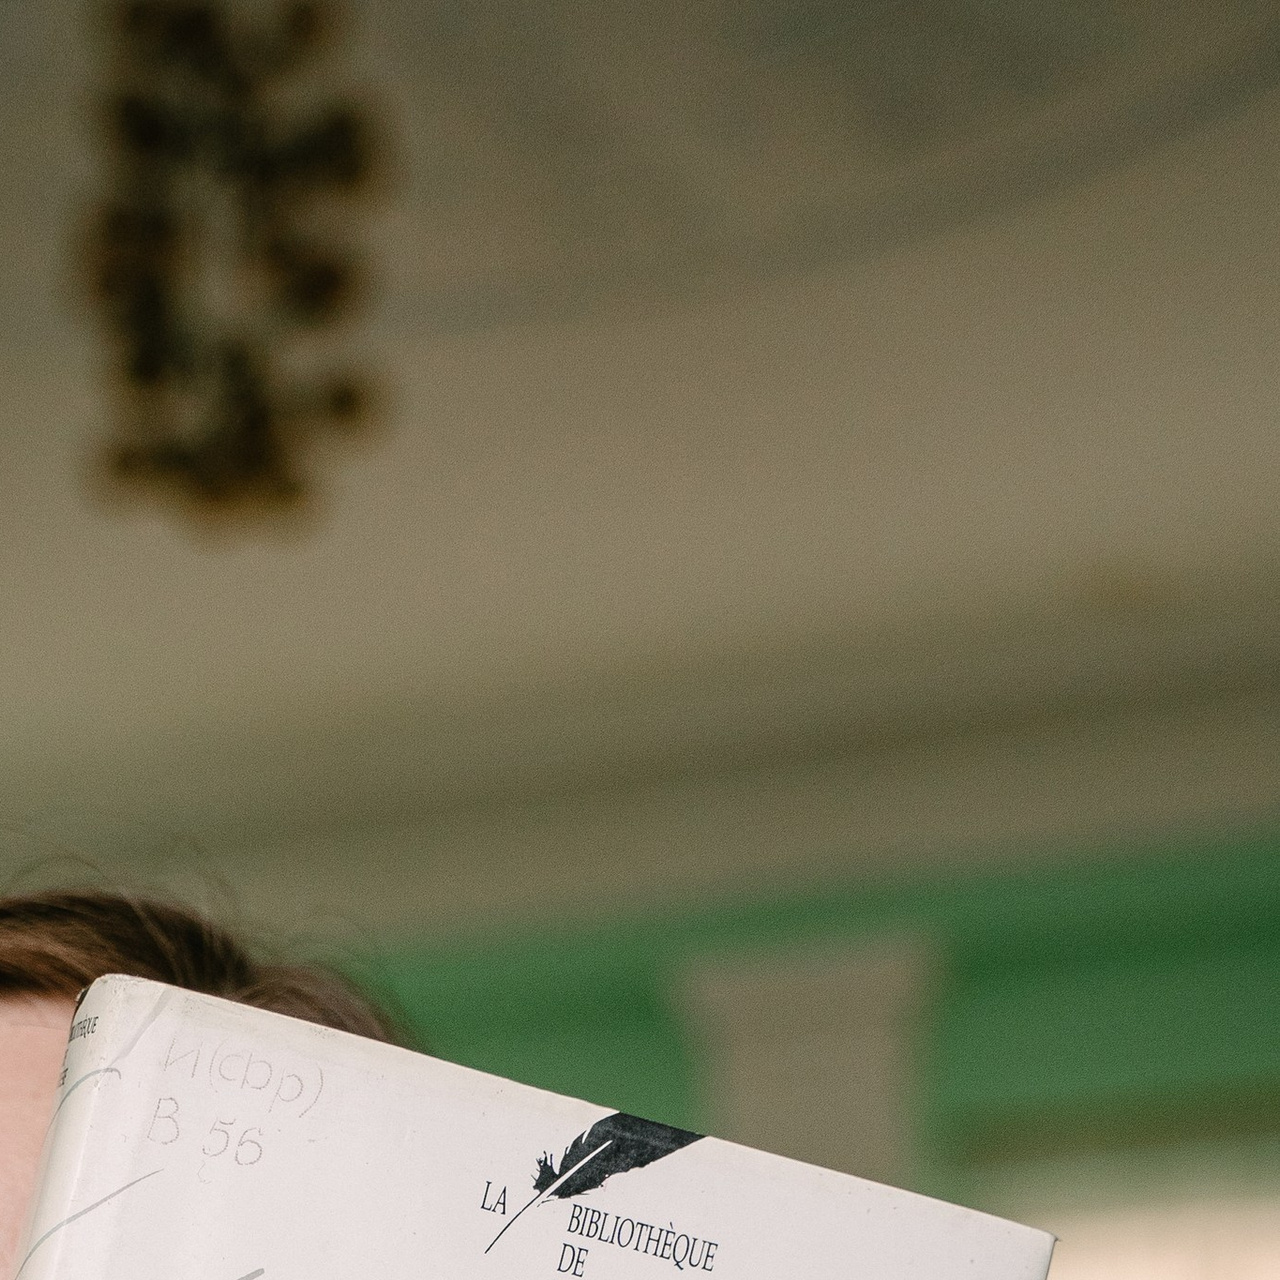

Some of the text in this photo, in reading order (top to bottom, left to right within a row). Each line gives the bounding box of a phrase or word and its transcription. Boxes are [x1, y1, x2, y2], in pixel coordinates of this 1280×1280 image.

[202, 1118, 264, 1167] 56
[480, 1180, 719, 1272] LA BIBLIOTHÈQUE
[556, 1242, 589, 1278] DE
